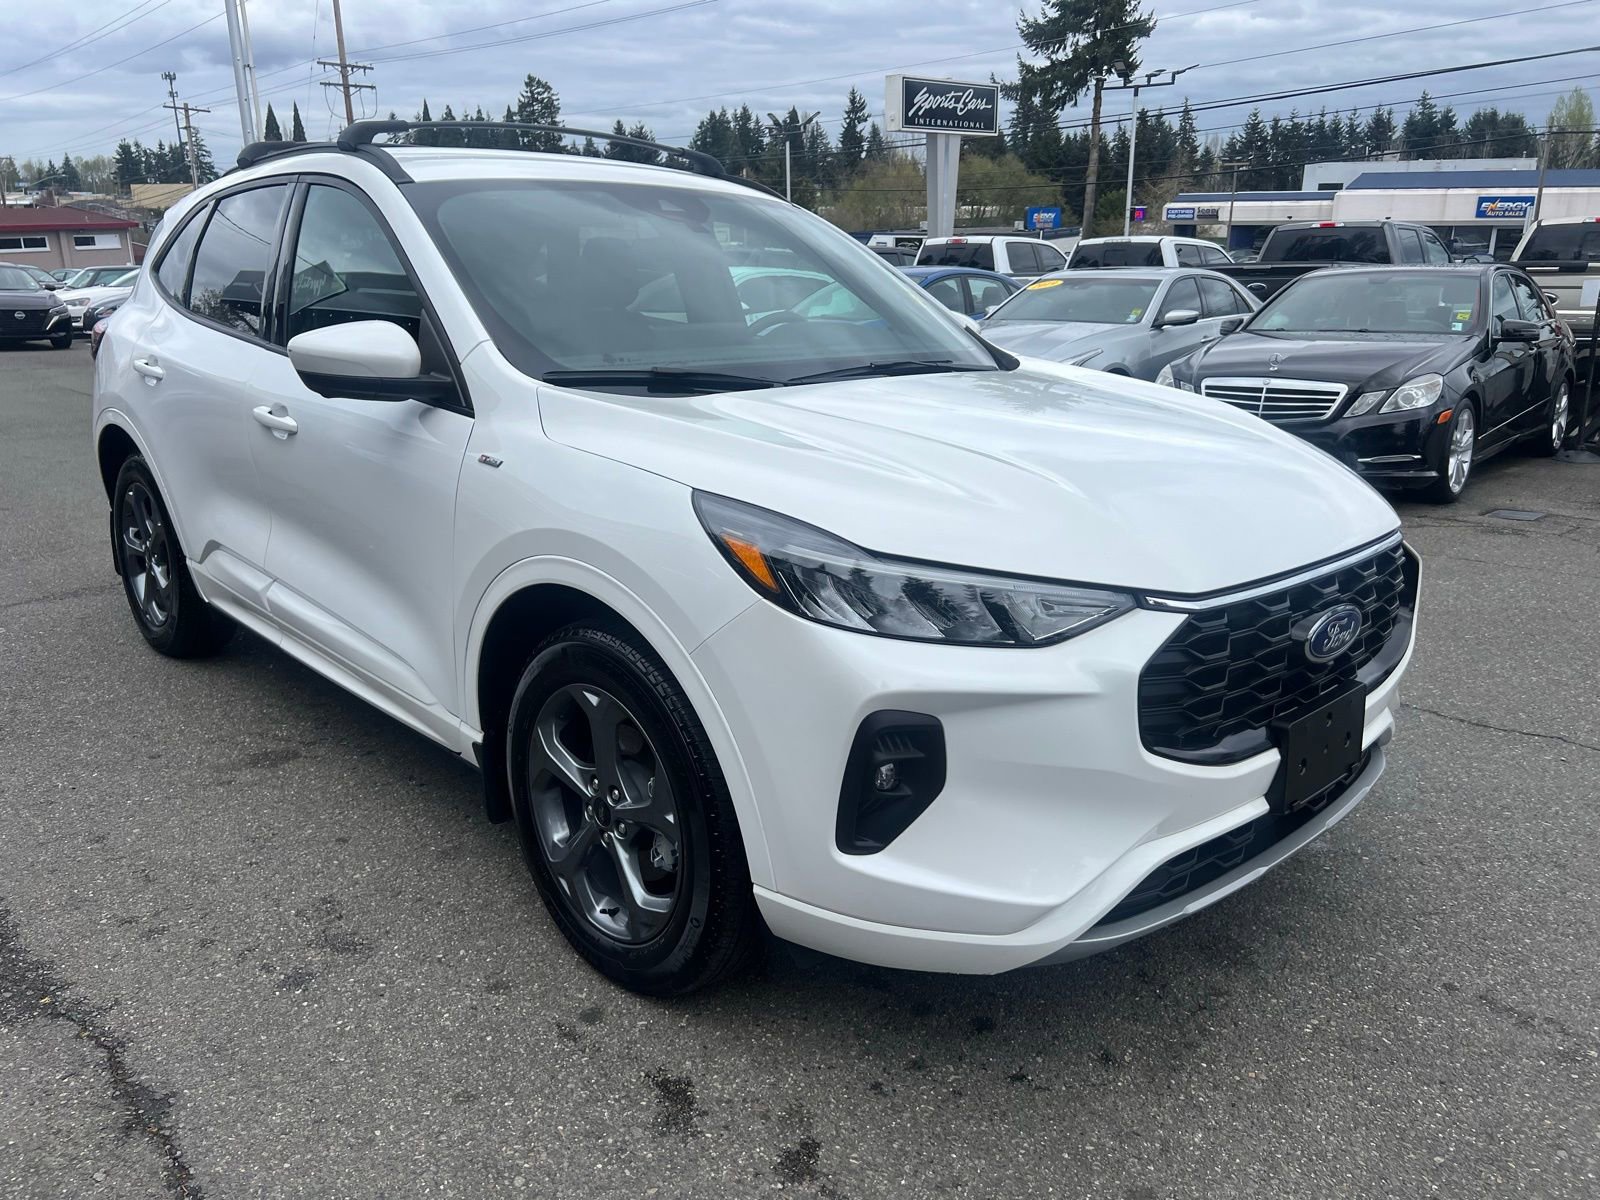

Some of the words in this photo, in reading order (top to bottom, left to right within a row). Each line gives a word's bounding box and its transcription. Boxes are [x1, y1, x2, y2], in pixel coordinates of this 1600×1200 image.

[908, 86, 963, 117] Sports
[957, 88, 992, 115] Cars
[914, 117, 985, 129] INTERNATIONAL
[1479, 200, 1532, 211] ENERGY
[1322, 617, 1355, 652] Ford
